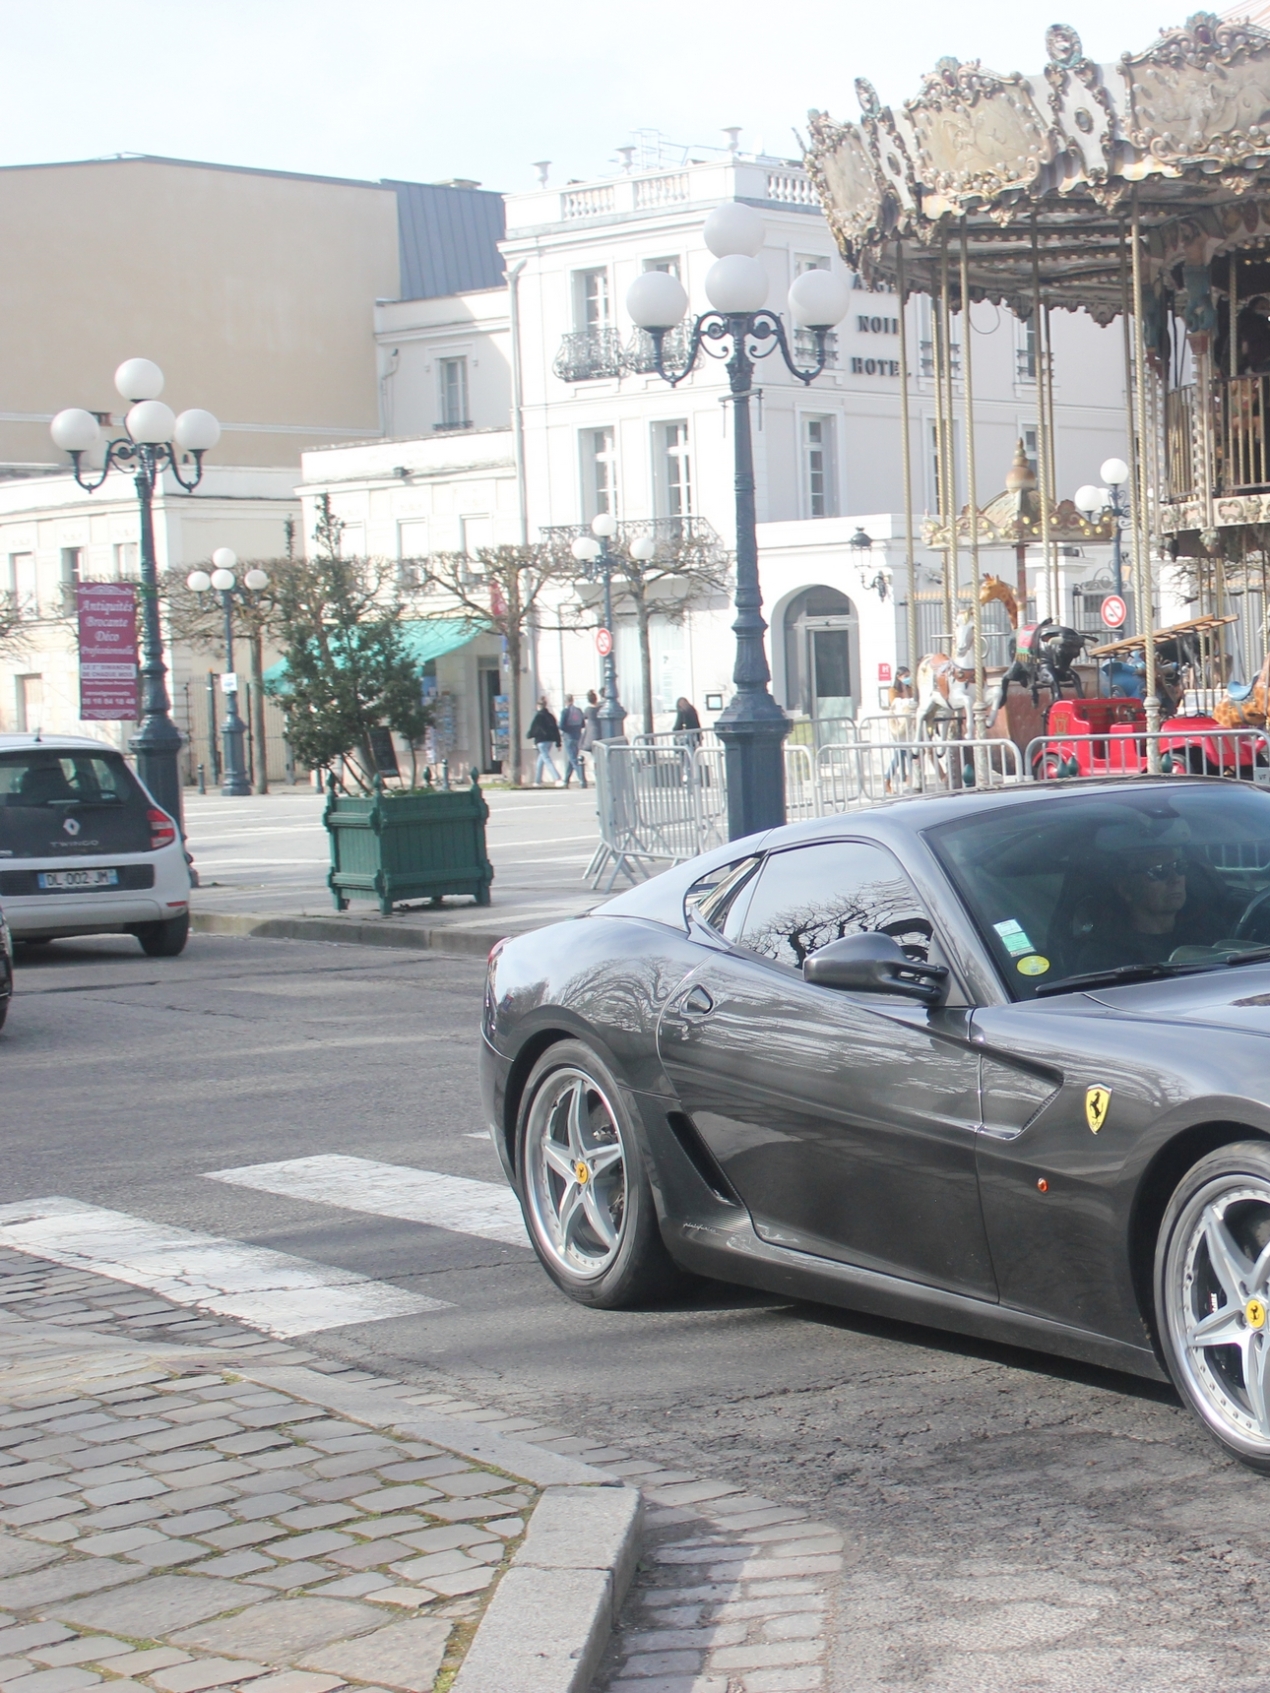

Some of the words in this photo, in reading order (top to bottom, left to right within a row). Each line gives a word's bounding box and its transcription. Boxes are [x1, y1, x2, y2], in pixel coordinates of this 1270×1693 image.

[852, 357, 911, 376] HOTE
[80, 600, 133, 615] Antiquités
[85, 616, 128, 627] Brocante
[94, 630, 120, 641] Déco
[50, 839, 99, 847] TWINGO
